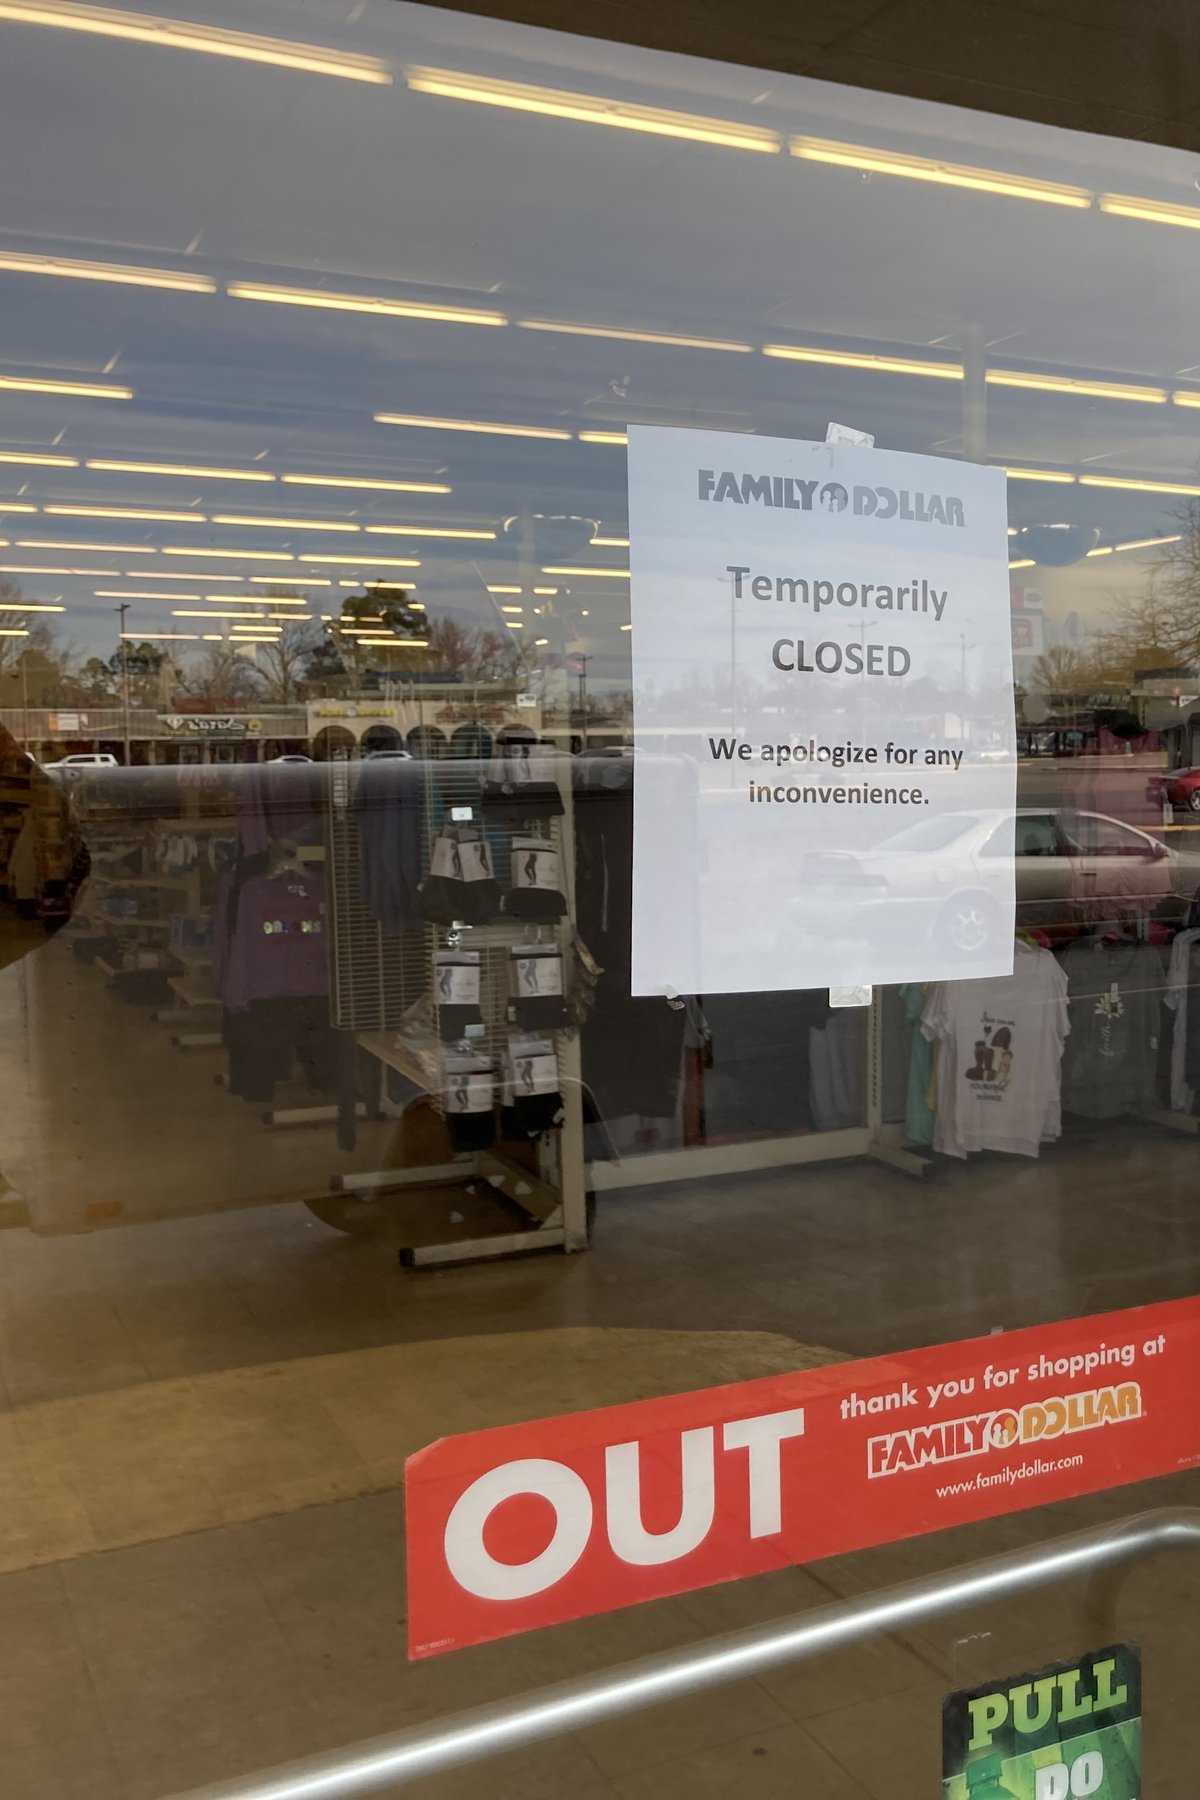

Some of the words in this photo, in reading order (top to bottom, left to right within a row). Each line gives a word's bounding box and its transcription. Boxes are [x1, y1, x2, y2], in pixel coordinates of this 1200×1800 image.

[698, 469, 819, 510] FAMILY
[853, 486, 966, 527] DOLLAR
[726, 566, 948, 621] Temporarily
[771, 639, 911, 676] CLOSED
[709, 738, 752, 760] We
[761, 740, 877, 768] apologize
[885, 742, 920, 764] for
[924, 747, 963, 770] any
[749, 781, 929, 805] inconvenience.
[841, 1386, 918, 1420] thank
[926, 1379, 976, 1409] you
[983, 1364, 1020, 1390] for
[1026, 1342, 1137, 1386] shopping
[1142, 1334, 1166, 1357] at
[867, 1413, 990, 1480] FAMILY
[1018, 1381, 1143, 1445] DOLLAR
[444, 1408, 805, 1600] OUT
[936, 1453, 1084, 1499] www.familydollar.com
[968, 1658, 1128, 1751] PULL
